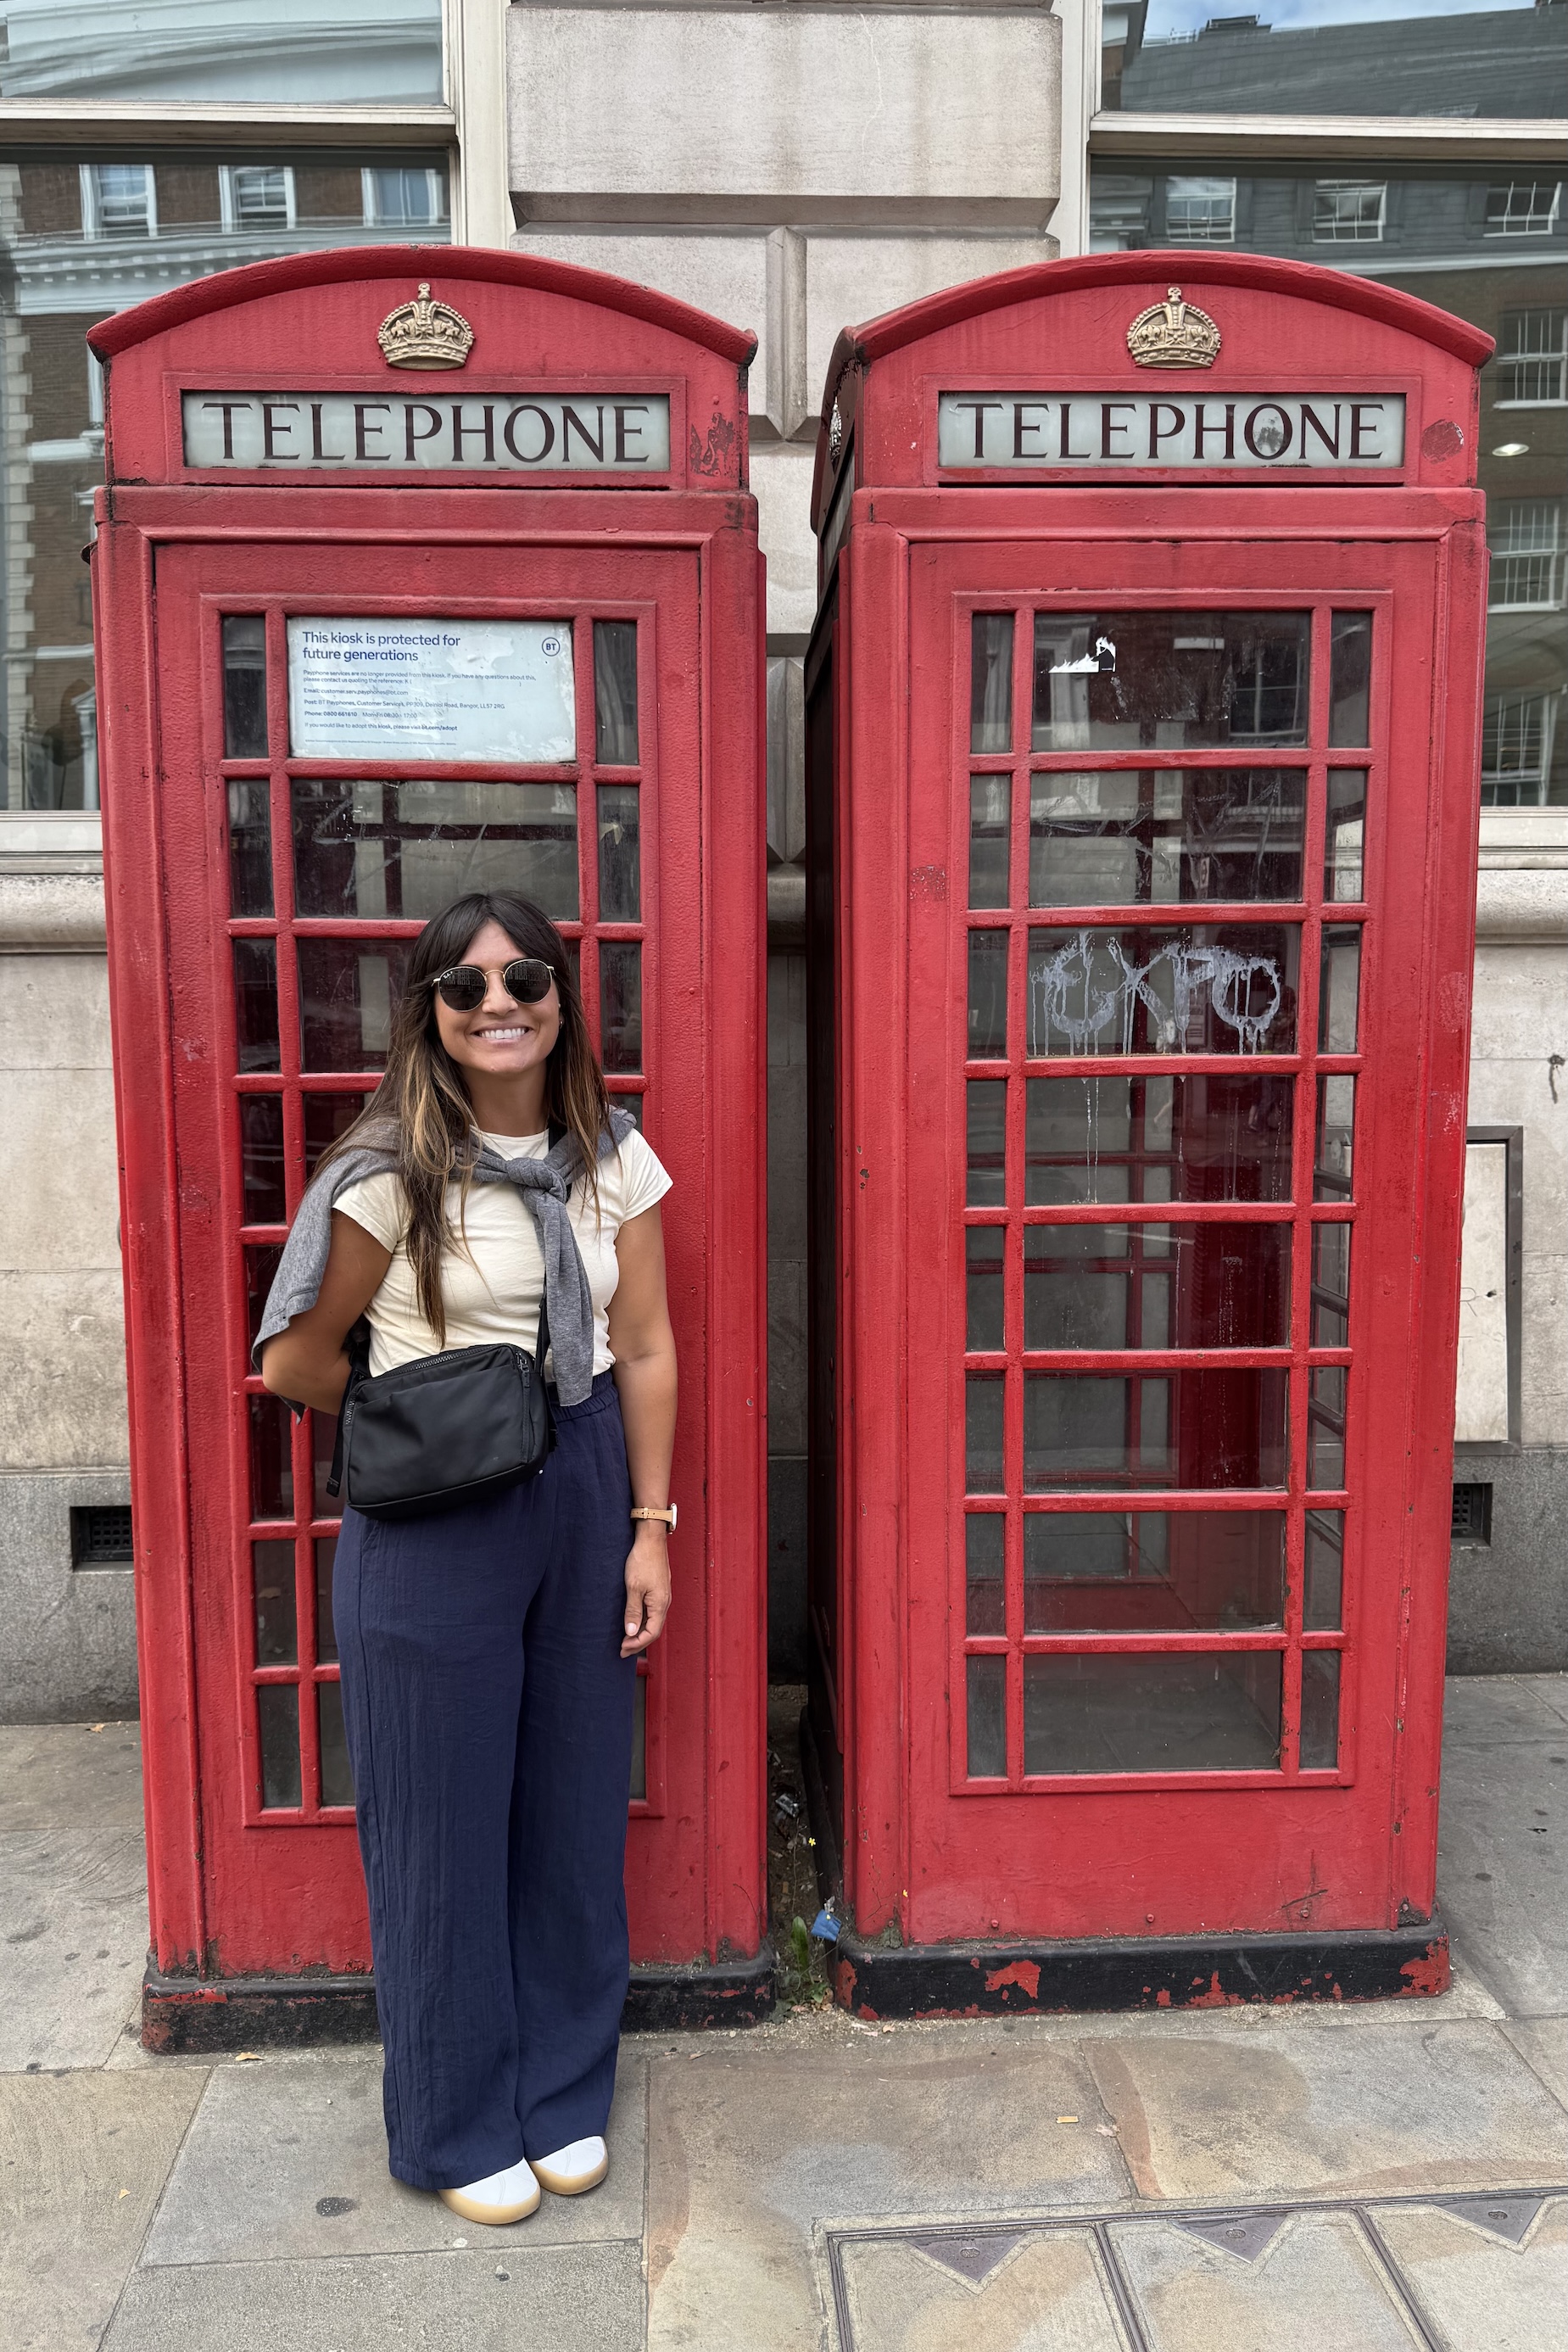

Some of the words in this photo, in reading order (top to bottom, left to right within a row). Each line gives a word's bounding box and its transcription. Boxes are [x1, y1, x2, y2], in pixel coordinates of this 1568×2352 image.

[201, 402, 650, 463] TELEPHONE
[955, 402, 1385, 461] TELEPHONE
[303, 631, 328, 644] This
[331, 632, 363, 645] kiosk
[366, 633, 376, 645] is
[378, 634, 440, 647] protected
[442, 634, 460, 646] for
[303, 647, 341, 660] future
[343, 650, 419, 662] generations
